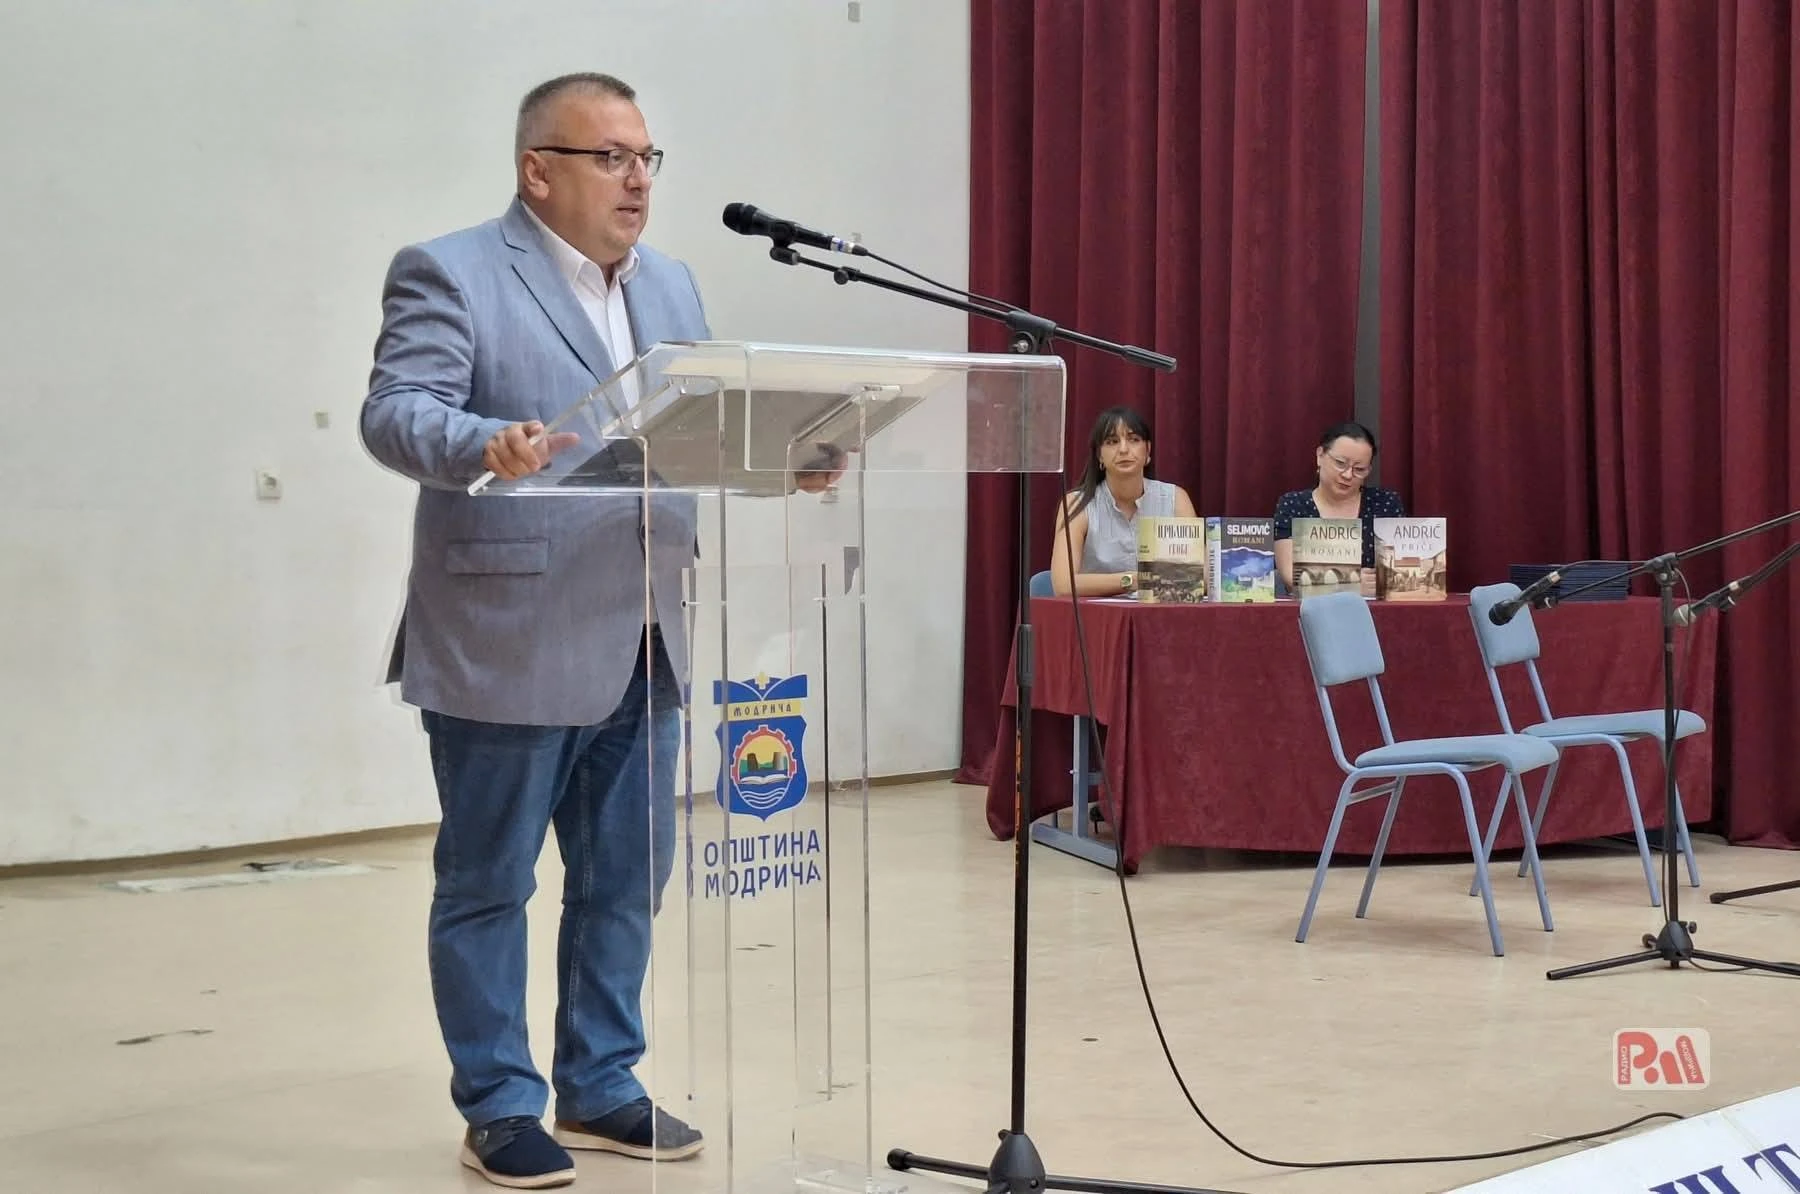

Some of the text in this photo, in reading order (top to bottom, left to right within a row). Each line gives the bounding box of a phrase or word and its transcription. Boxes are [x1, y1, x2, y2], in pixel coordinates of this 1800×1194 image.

[1227, 522, 1270, 535] SELIMOVIĆ
[1310, 523, 1359, 540] ANDRIĆ
[1394, 523, 1441, 539] ANDRIĆ
[1232, 536, 1265, 545] ROMANI
[1310, 546, 1357, 555] ROMANI
[704, 829, 821, 868] ОПШТИНА
[705, 860, 821, 899] МОДРИЧА
